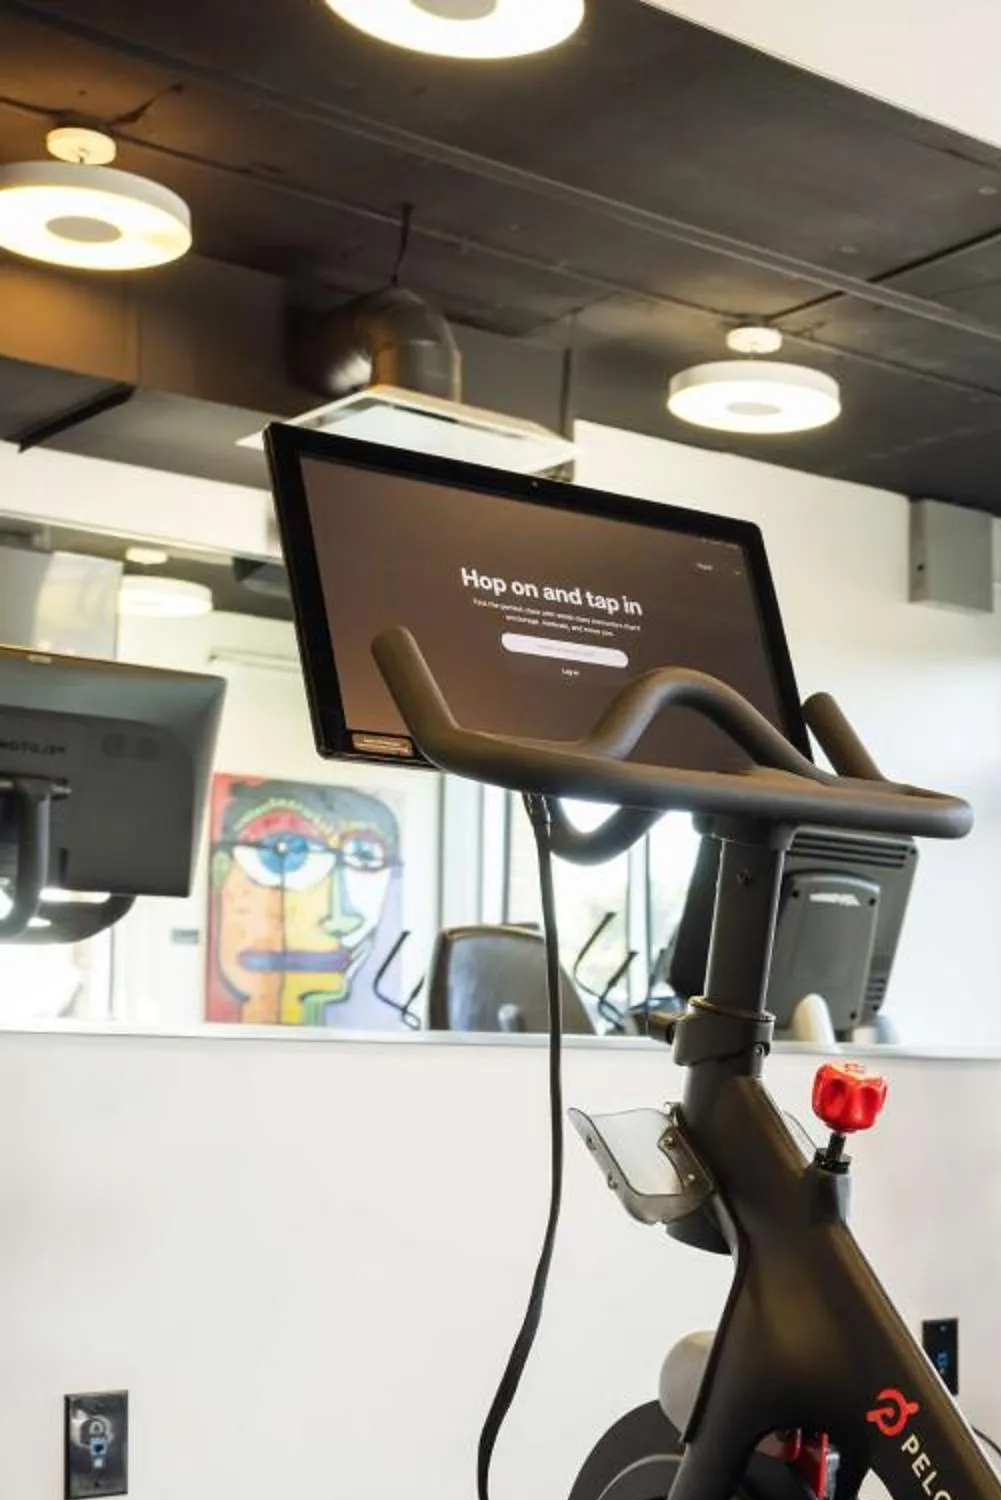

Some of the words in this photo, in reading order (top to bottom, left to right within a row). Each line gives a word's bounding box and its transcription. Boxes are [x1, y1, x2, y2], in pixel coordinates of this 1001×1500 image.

[460, 567, 507, 596] Hop
[511, 581, 539, 598] on
[543, 587, 583, 606] and
[585, 590, 620, 615] tap
[623, 595, 643, 616] in
